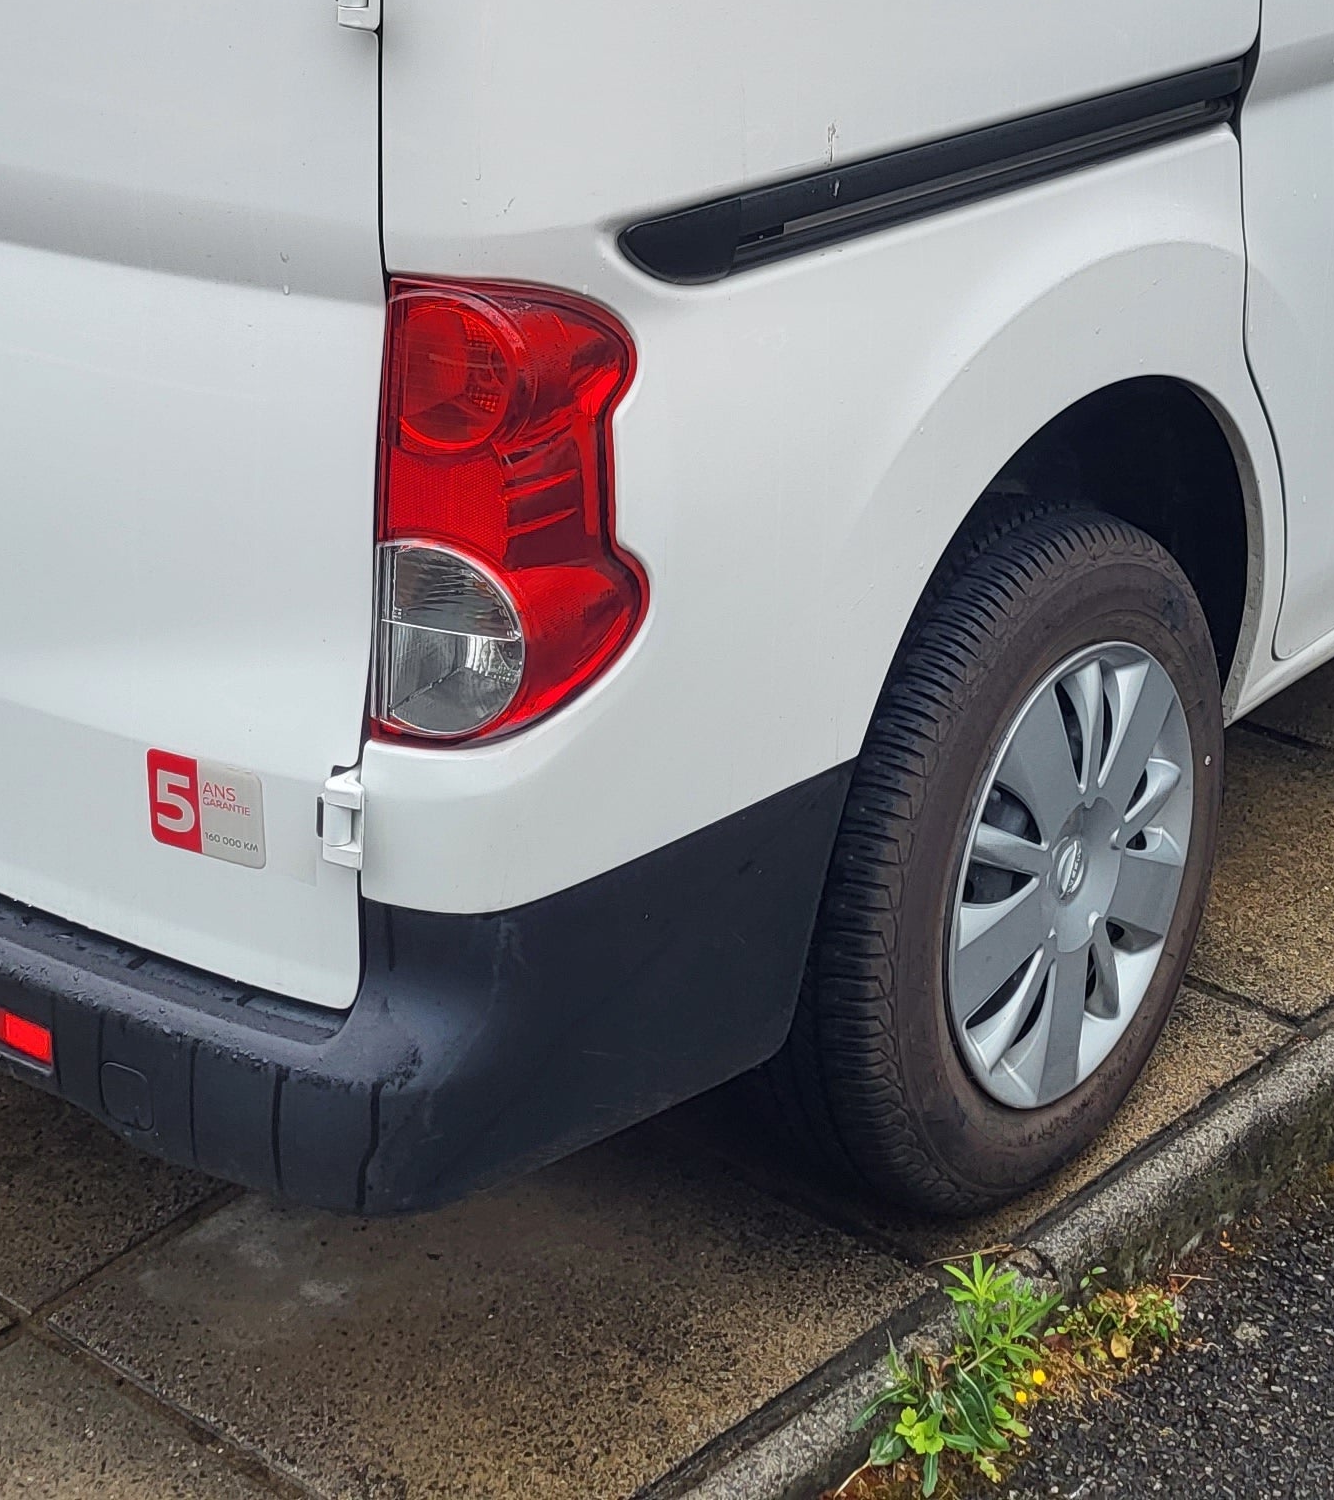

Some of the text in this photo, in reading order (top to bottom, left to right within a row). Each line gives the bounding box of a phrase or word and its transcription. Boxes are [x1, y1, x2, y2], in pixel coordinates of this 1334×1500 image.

[157, 768, 196, 833] 5
[203, 781, 236, 802] ANS
[202, 796, 251, 817] GARANTIE
[204, 831, 259, 853] 160 000 KM
